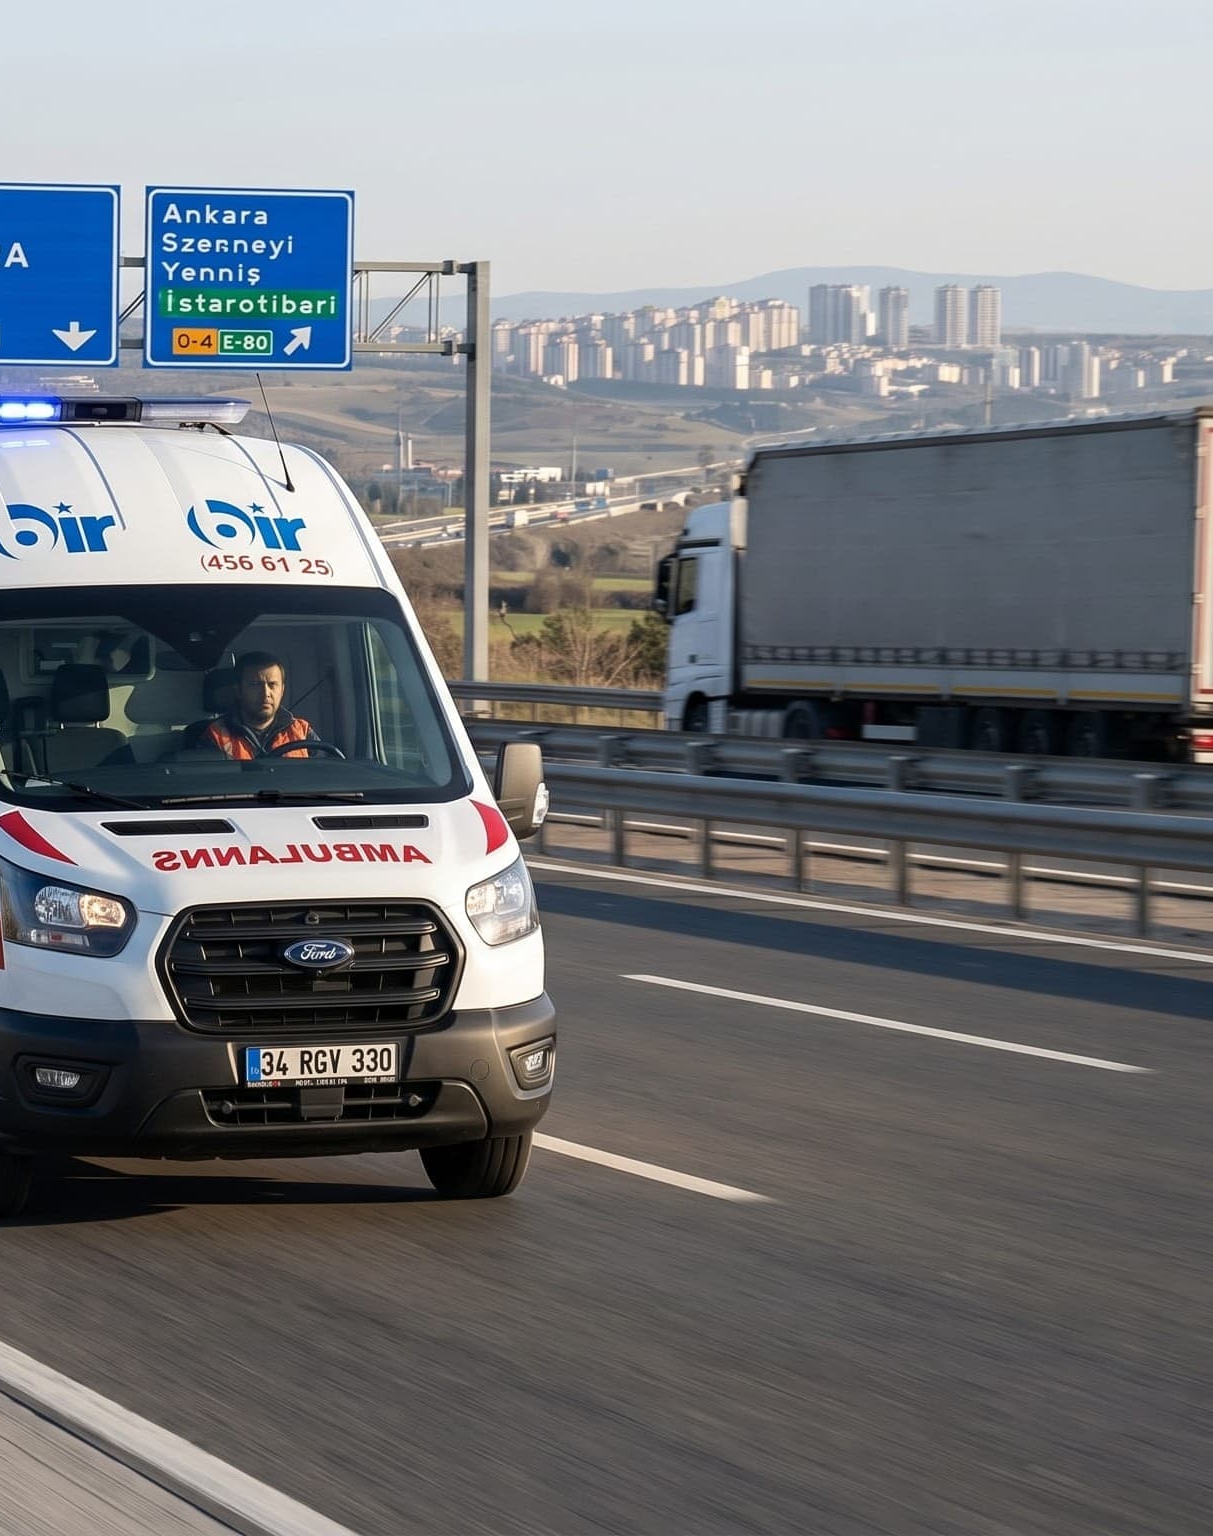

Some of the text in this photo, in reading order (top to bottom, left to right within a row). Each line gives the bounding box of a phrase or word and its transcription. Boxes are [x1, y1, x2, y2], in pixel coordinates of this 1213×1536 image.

[162, 203, 268, 225] Ankara
[161, 261, 261, 286] Yenniş
[223, 335, 268, 350] E-80
[200, 554, 334, 578] (456 61 25)
[300, 943, 337, 961] Ford
[261, 1047, 393, 1076] 34 RGV 330
